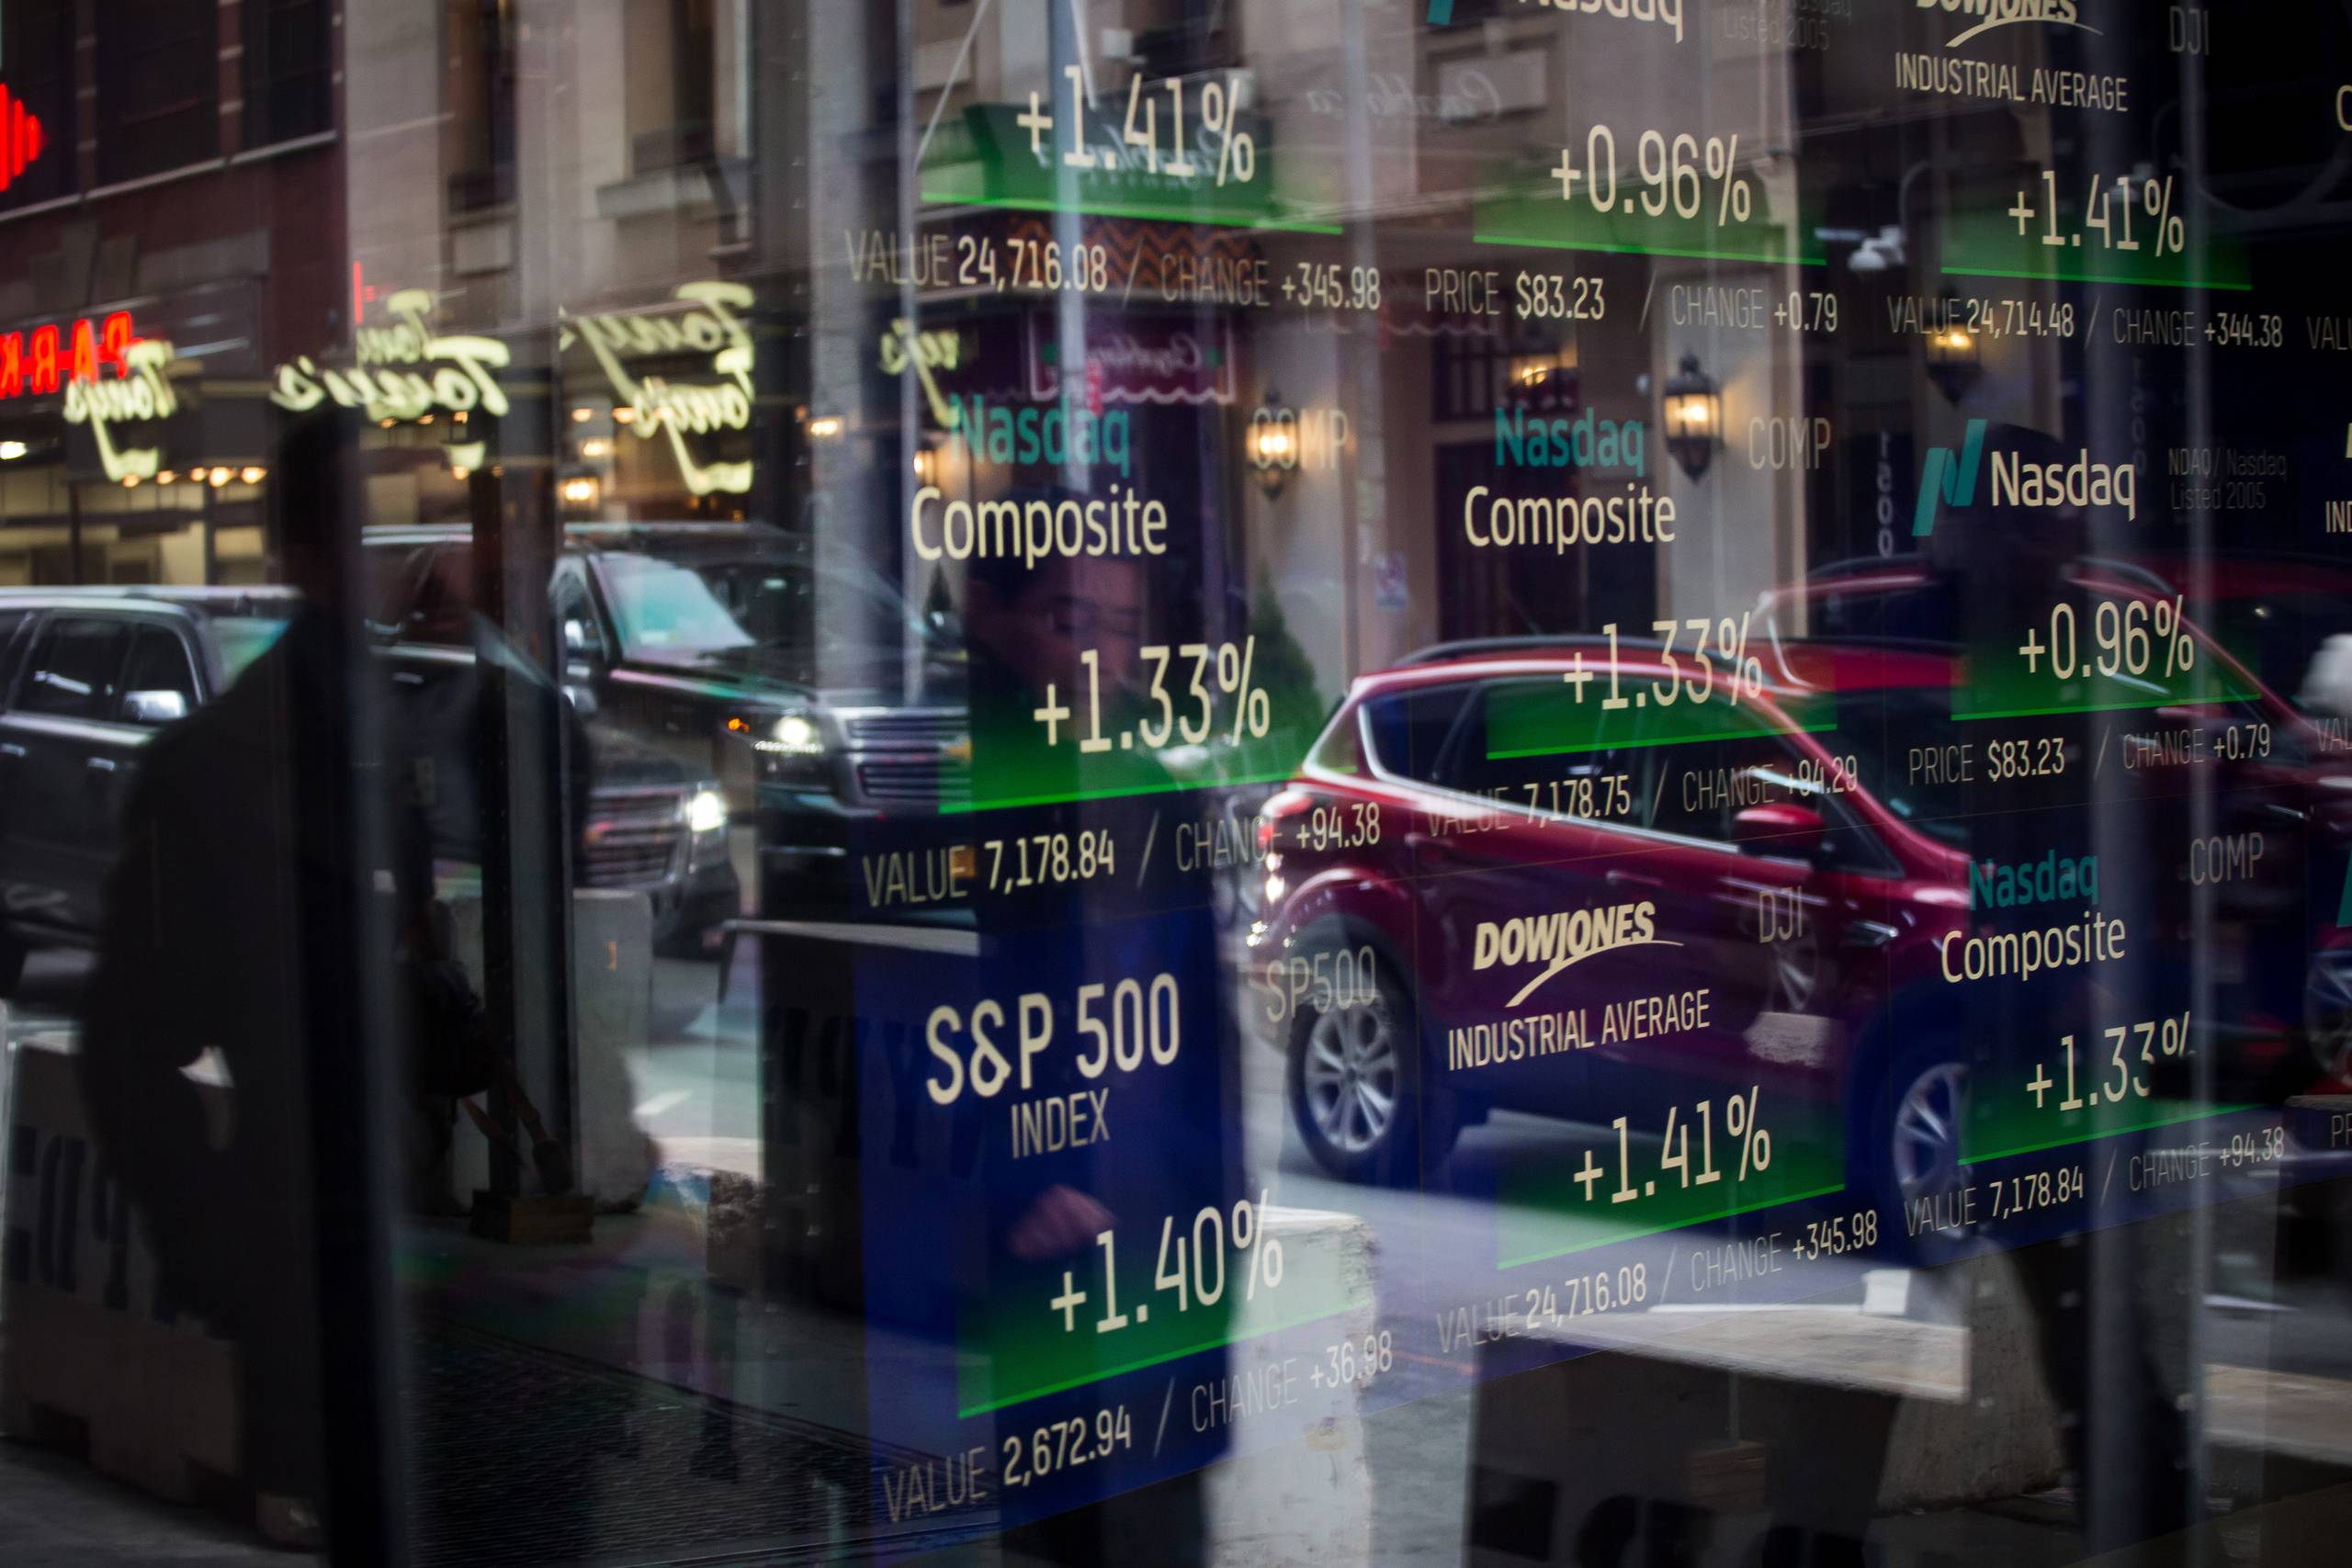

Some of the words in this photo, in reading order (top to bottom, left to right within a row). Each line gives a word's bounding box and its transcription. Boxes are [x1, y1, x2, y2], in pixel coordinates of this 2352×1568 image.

[2170, 6, 2209, 56] DJI
[1895, 52, 2026, 102] INDUSTRIAL
[2031, 68, 2128, 112] AVERAGE
[1017, 65, 1255, 187] +1.41%
[1551, 125, 1750, 227] +0.96%
[2008, 171, 2184, 257] +1.41%
[845, 230, 951, 288] VALUE
[958, 236, 1107, 293] 24,716.08
[1161, 253, 1271, 307] CHANGE
[1283, 263, 1381, 311] +345.98
[1425, 268, 1499, 316] PRICE
[1516, 271, 1605, 321] $83.23
[1671, 284, 1765, 331] CHANGE
[1774, 291, 1838, 333] +0.79
[1966, 298, 2075, 339] 24,714.48
[2113, 308, 2195, 347] CHANGE
[2204, 312, 2283, 348] +344.38
[949, 393, 1129, 479] Nasdaq
[1495, 406, 1644, 478] Nasdaq
[1748, 416, 1831, 470] COMP
[1464, 482, 1676, 556] Composite
[1991, 449, 2136, 521] Nasdaq
[2226, 481, 2267, 511] 2005
[911, 484, 1167, 570] Composite
[1564, 611, 1762, 710] +1.33%
[2019, 594, 2194, 680] +0.96%
[1034, 635, 1270, 753] +1.33%
[1909, 745, 1974, 786] PRICE
[1987, 738, 2065, 782] $83.23
[2122, 728, 2204, 770] CHANGE
[2213, 723, 2270, 761] +0.79
[1523, 774, 1632, 829] 7,178.75
[1682, 763, 1775, 812] CHANGE
[862, 844, 968, 908] VALUE
[985, 829, 1114, 896] 7,178.84
[1296, 802, 1380, 852] +94.38
[1970, 851, 2098, 911] Nasdaq
[2190, 832, 2264, 886] COMP
[1759, 886, 1803, 943] DJI
[1941, 911, 2126, 981] Composite
[1265, 945, 1376, 1023] SP500
[925, 992, 1057, 1105] S&P
[1076, 973, 1180, 1079] 500
[1449, 1009, 1594, 1071] INDUSTRIAL
[1601, 988, 1711, 1044] AVERAGE
[1012, 1088, 1110, 1159] INDEX
[1574, 1085, 1770, 1204] +1.41%
[1904, 1187, 1977, 1236] VALUE
[1989, 1166, 2084, 1220] 7,178.84
[2129, 1142, 2211, 1192] CHANGE
[2220, 1127, 2285, 1168] +94.38
[1050, 1189, 1283, 1334] +1.40%
[1438, 1293, 1521, 1353] VALUE
[1526, 1263, 1646, 1331] 24,716.08
[1690, 1233, 1782, 1292] CHANGE
[1792, 1209, 1877, 1261] +345.98
[882, 1447, 987, 1524] VALUE
[1002, 1404, 1131, 1488] 2,672.94
[1191, 1357, 1299, 1433] CHANGE
[1310, 1329, 1393, 1390] +36.98
